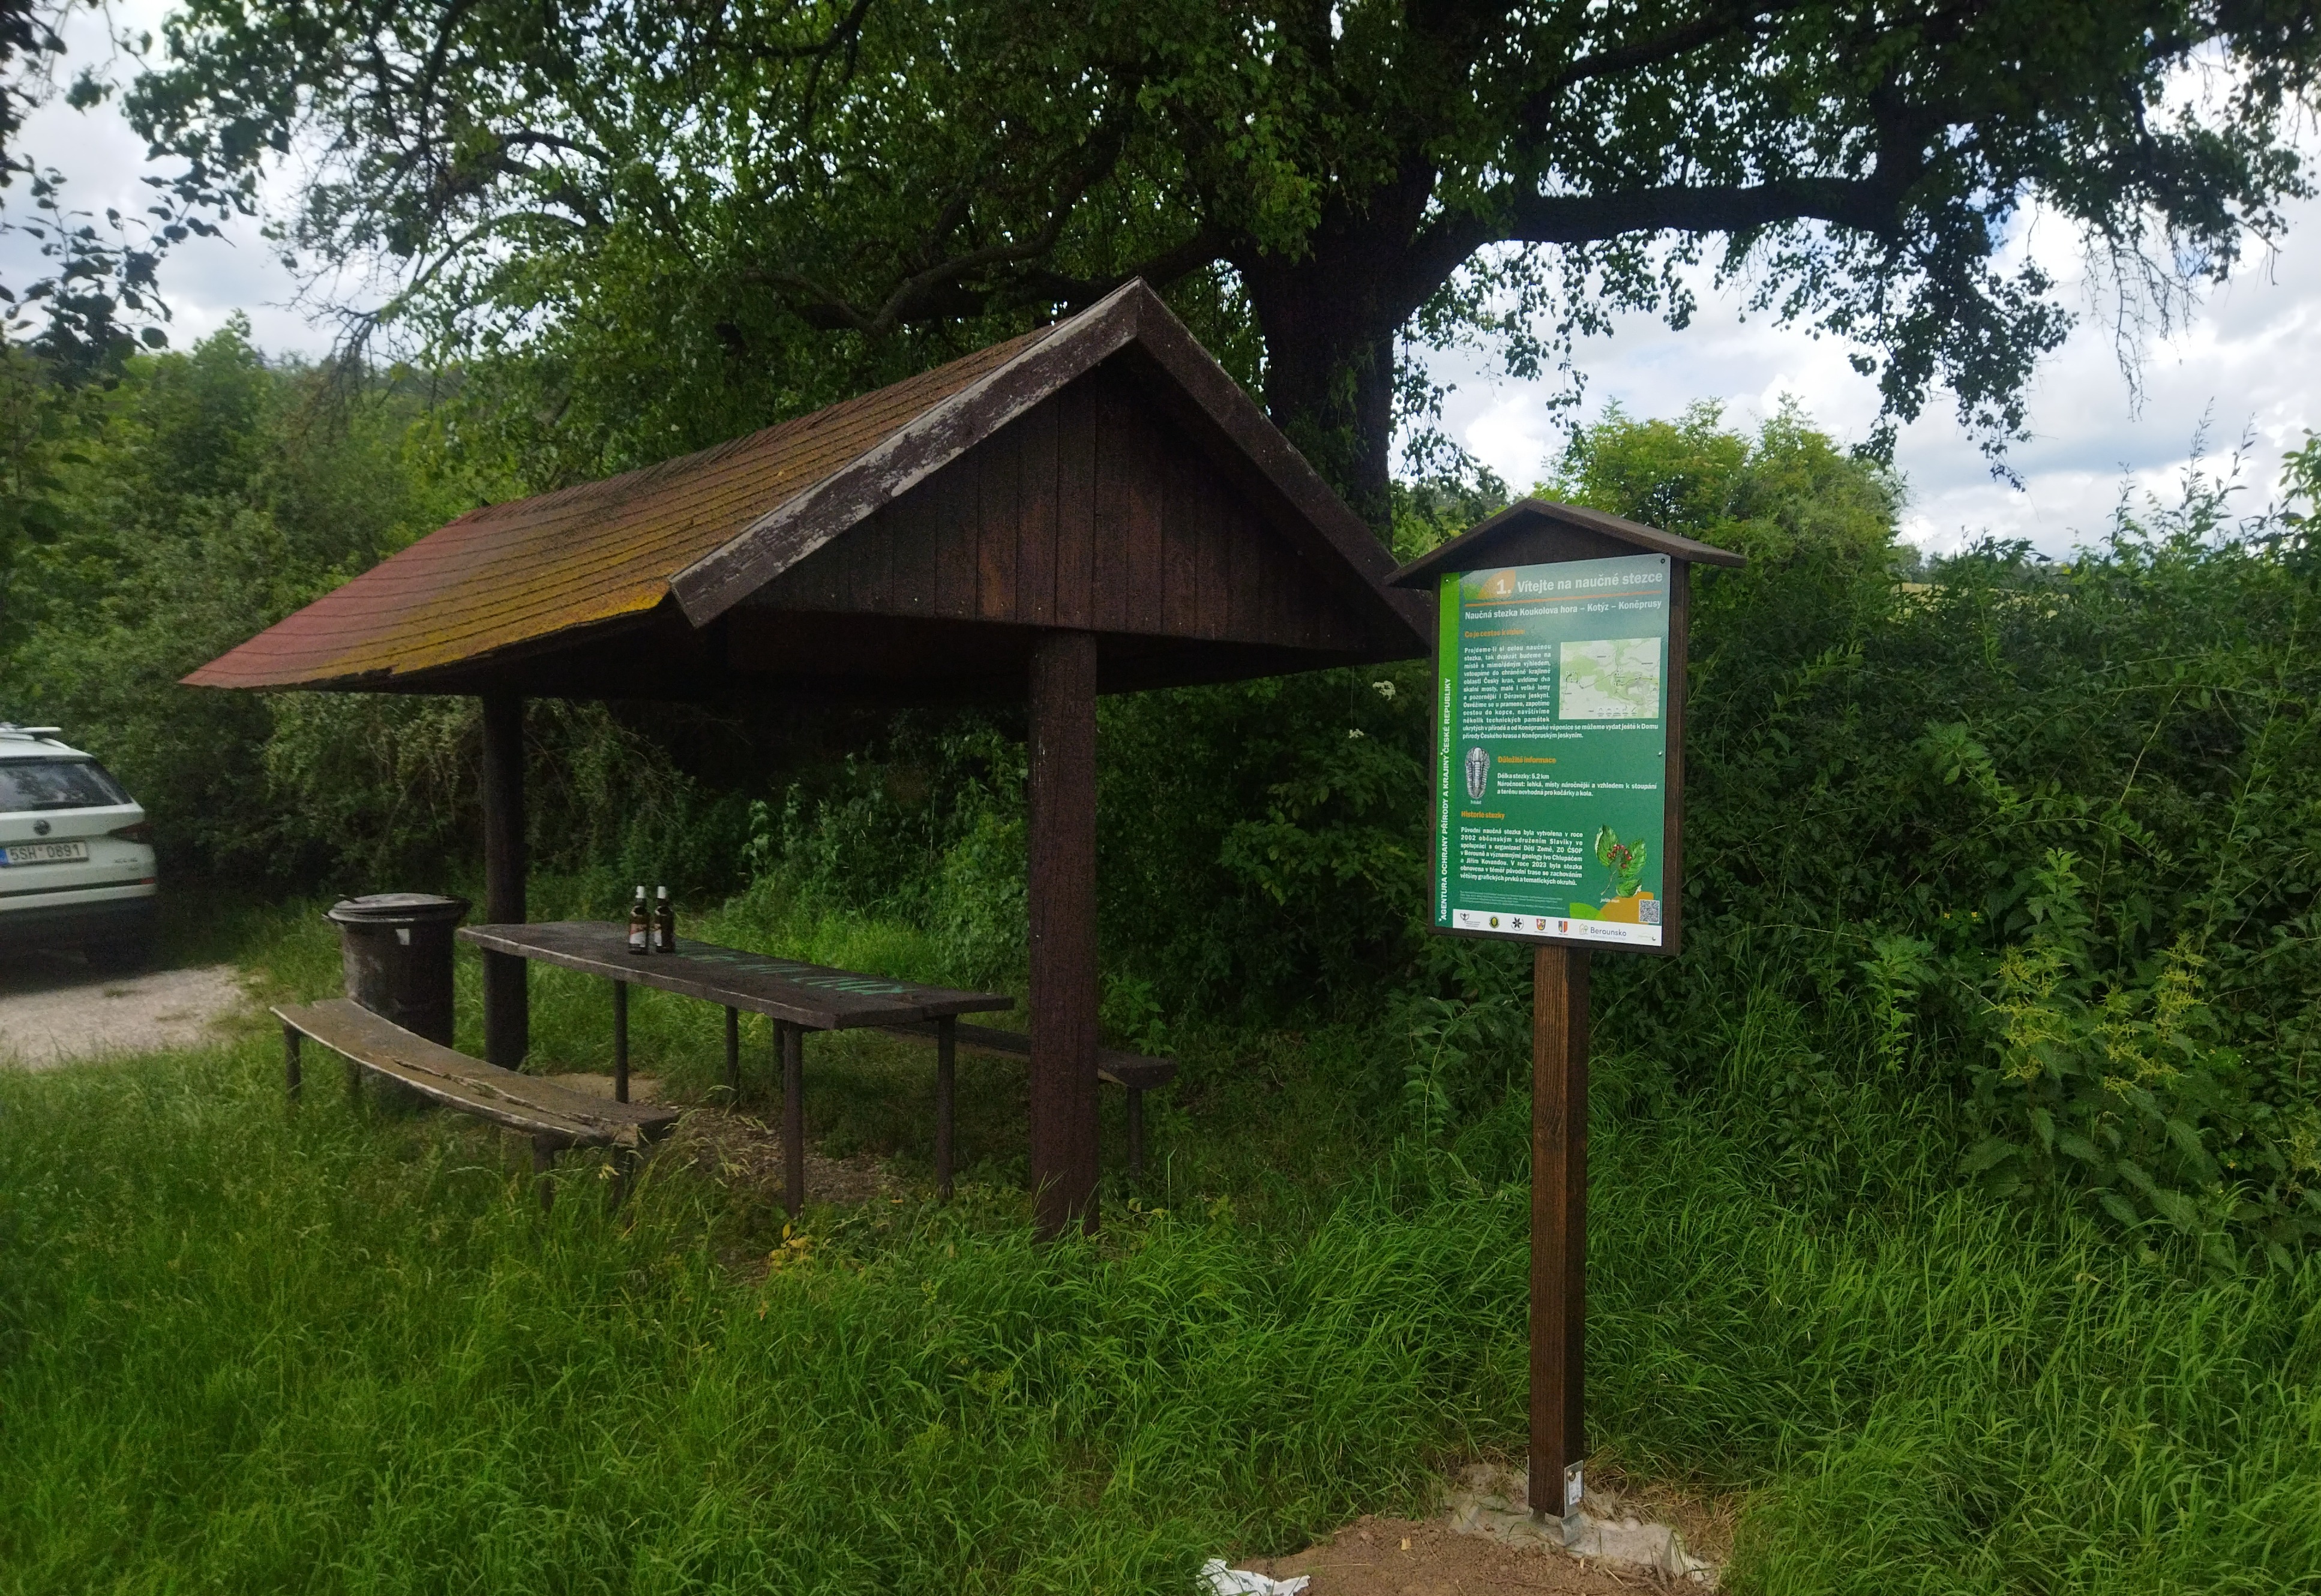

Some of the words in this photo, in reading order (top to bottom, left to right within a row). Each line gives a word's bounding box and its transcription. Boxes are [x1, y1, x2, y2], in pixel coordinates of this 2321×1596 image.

[1497, 579, 1512, 594] 1.
[1518, 580, 1554, 593] Vítejte
[1558, 580, 1571, 589] na
[1576, 573, 1619, 588] naučné
[1623, 573, 1662, 584] stezce
[1465, 610, 1492, 620] Naučná
[1494, 609, 1518, 617] stezka
[1520, 607, 1558, 616] Koukolova
[1587, 602, 1609, 613] Kotýz
[1619, 600, 1662, 610] Koněprusy
[1591, 926, 1627, 936] Berounsko
